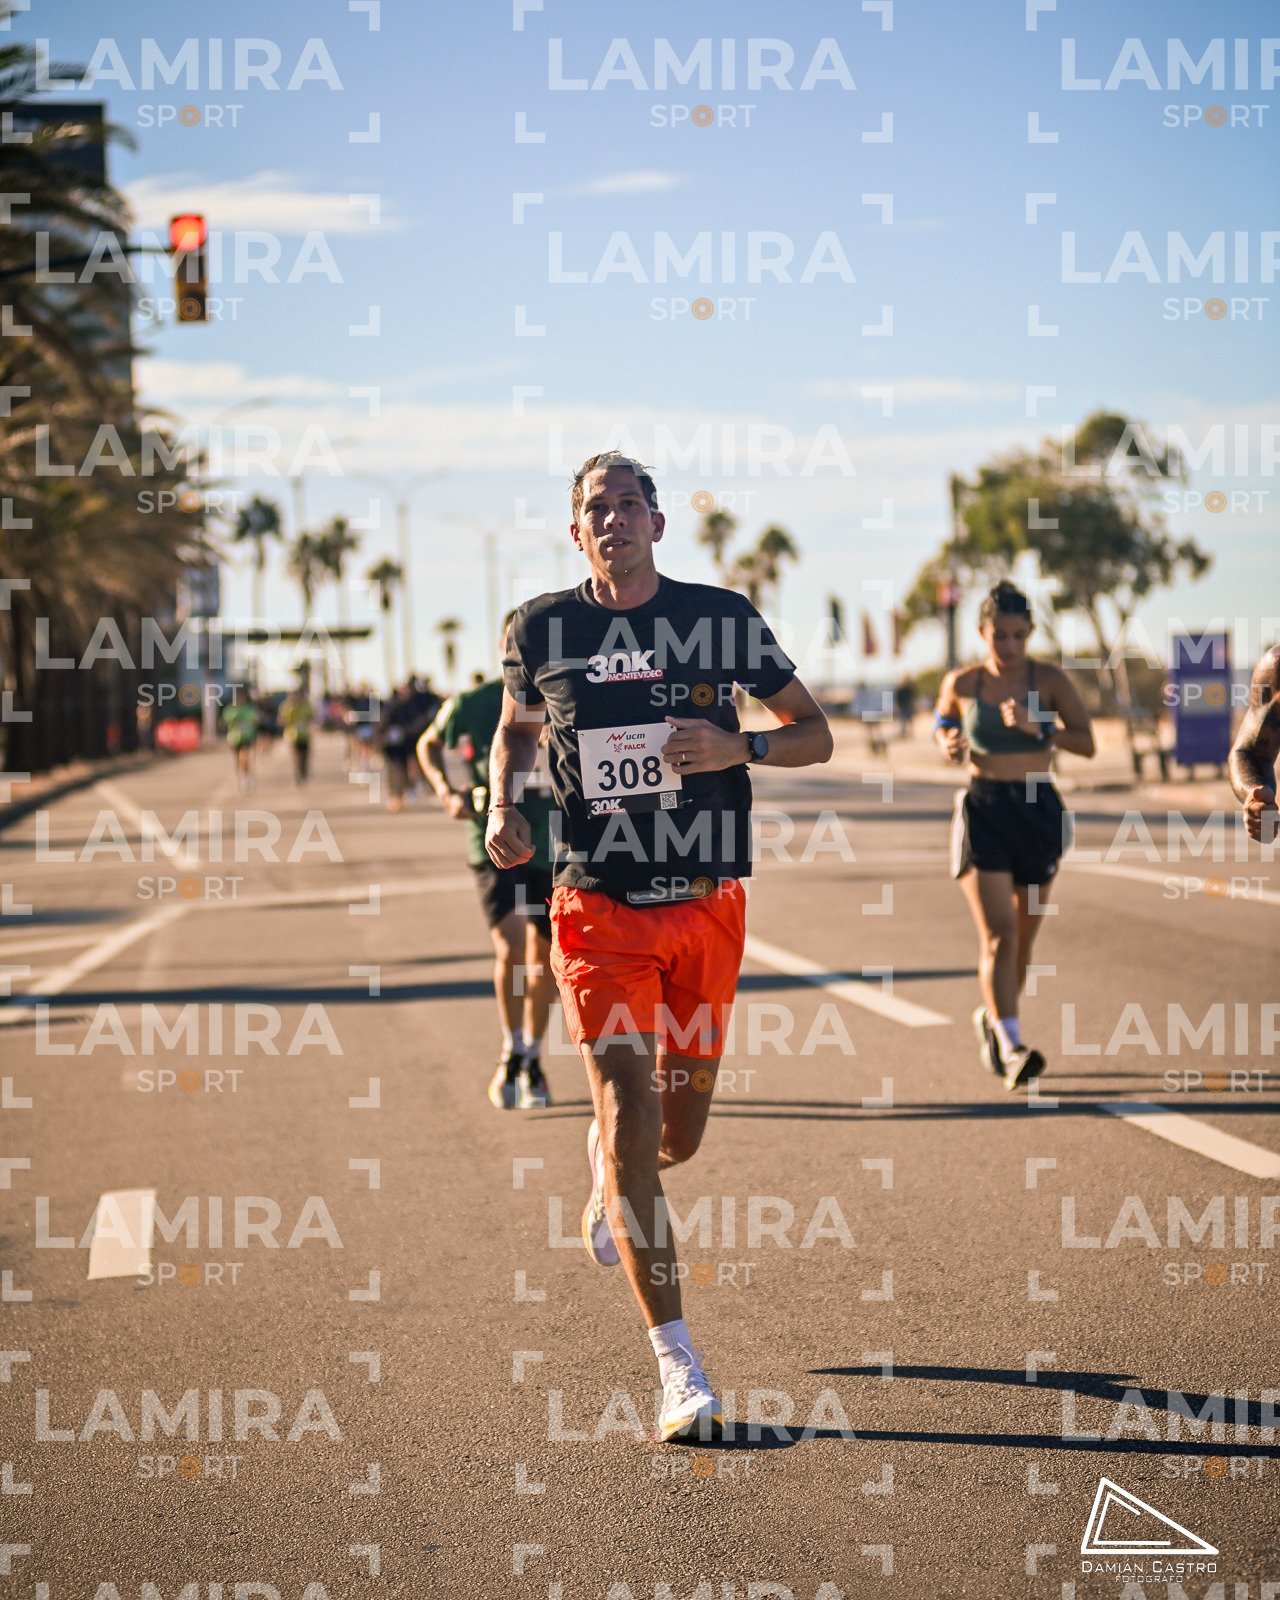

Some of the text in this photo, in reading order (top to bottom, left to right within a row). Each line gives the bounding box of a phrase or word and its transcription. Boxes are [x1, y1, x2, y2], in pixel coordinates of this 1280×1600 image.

[586, 650, 655, 683] 30K
[626, 732, 646, 740] ucm
[624, 742, 646, 751] FALCK
[597, 755, 663, 792] 308
[591, 798, 622, 816] 30K
